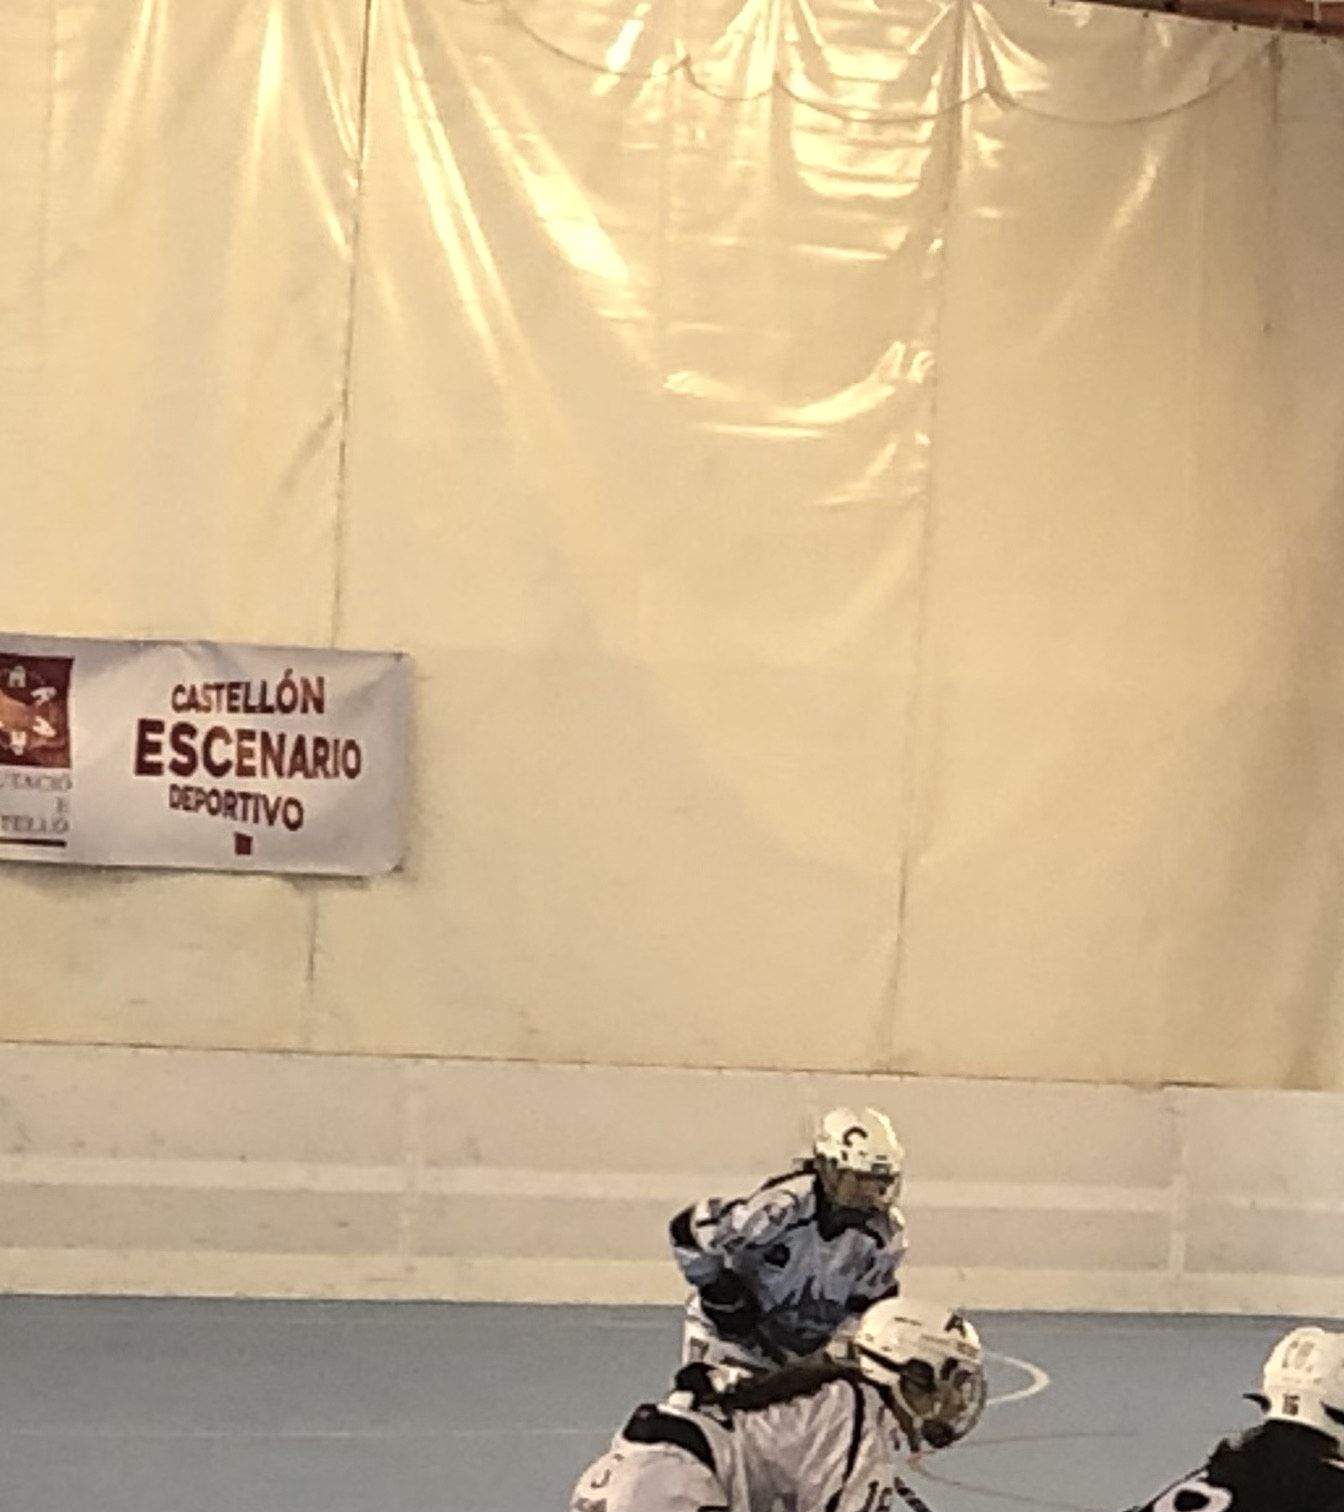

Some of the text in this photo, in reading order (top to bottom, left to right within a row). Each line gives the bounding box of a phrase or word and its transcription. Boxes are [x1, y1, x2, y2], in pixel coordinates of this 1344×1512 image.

[172, 668, 325, 714] CASTELLÓN
[135, 718, 362, 779] ESCENARIO
[169, 783, 304, 831] DEPORTIVO
